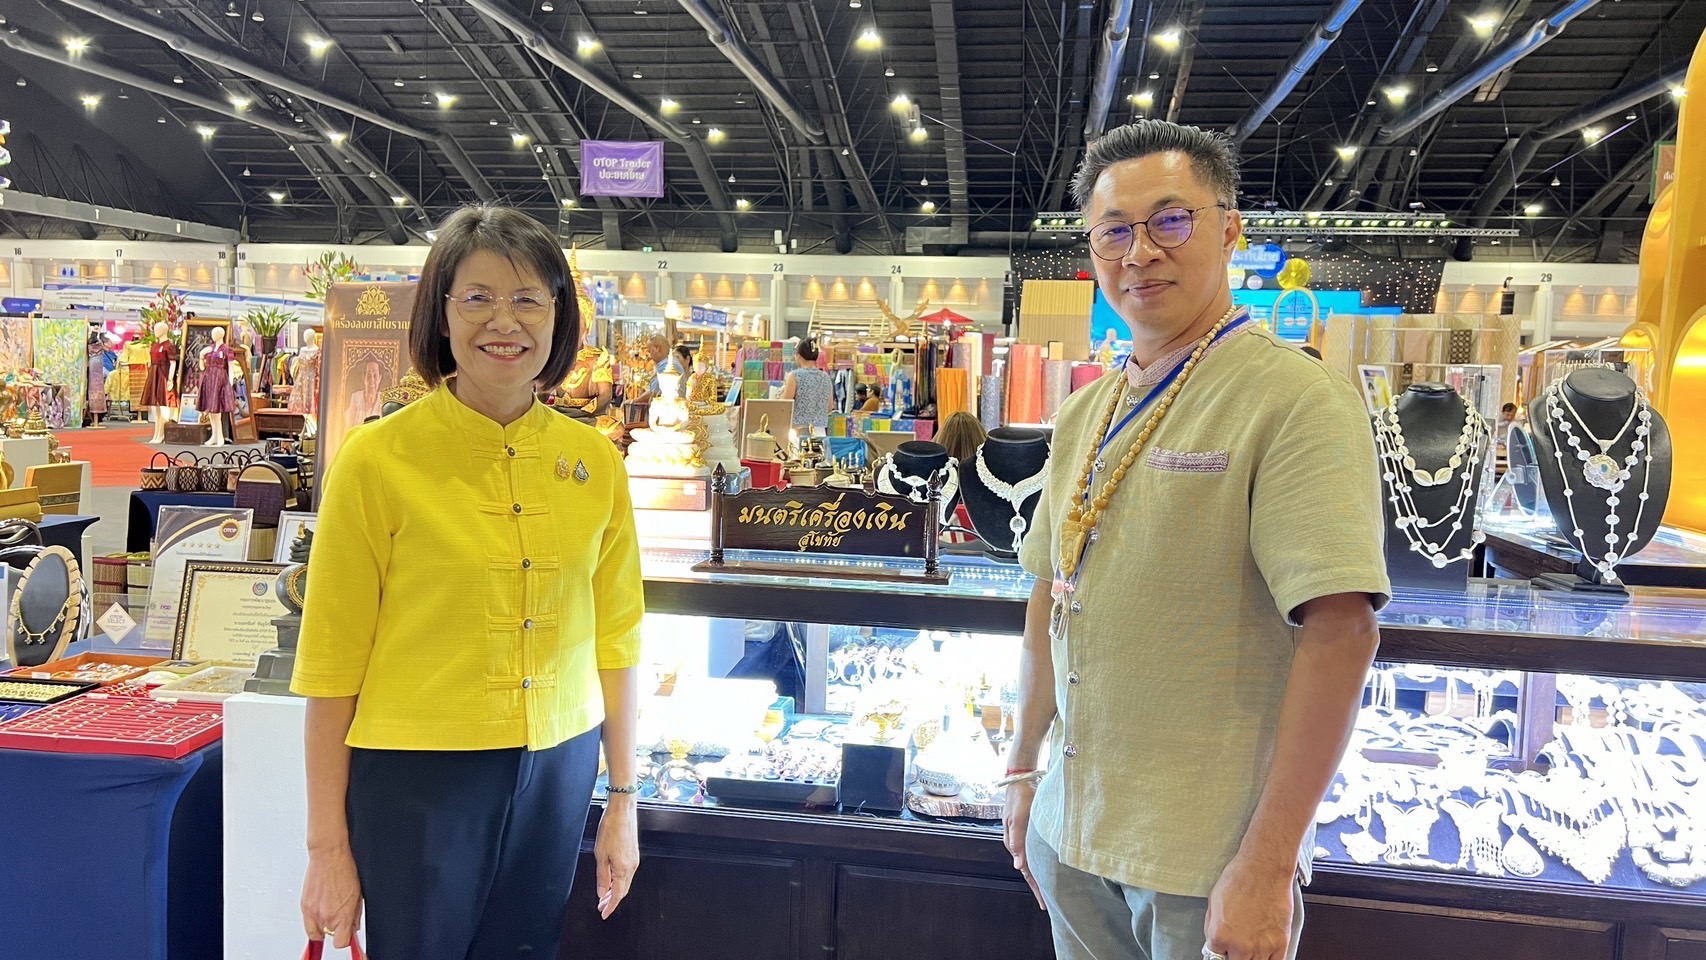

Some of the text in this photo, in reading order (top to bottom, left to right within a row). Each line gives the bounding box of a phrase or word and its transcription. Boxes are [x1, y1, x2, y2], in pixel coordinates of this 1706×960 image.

[593, 157, 651, 169] OTOP Trader
[14, 247, 22, 256] 16
[115, 249, 123, 257] 17
[218, 251, 226, 260] 18
[238, 252, 246, 261] 18
[657, 260, 668, 270] 22
[773, 263, 784, 272] 23
[891, 265, 901, 274] 24
[1540, 273, 1552, 282] 29
